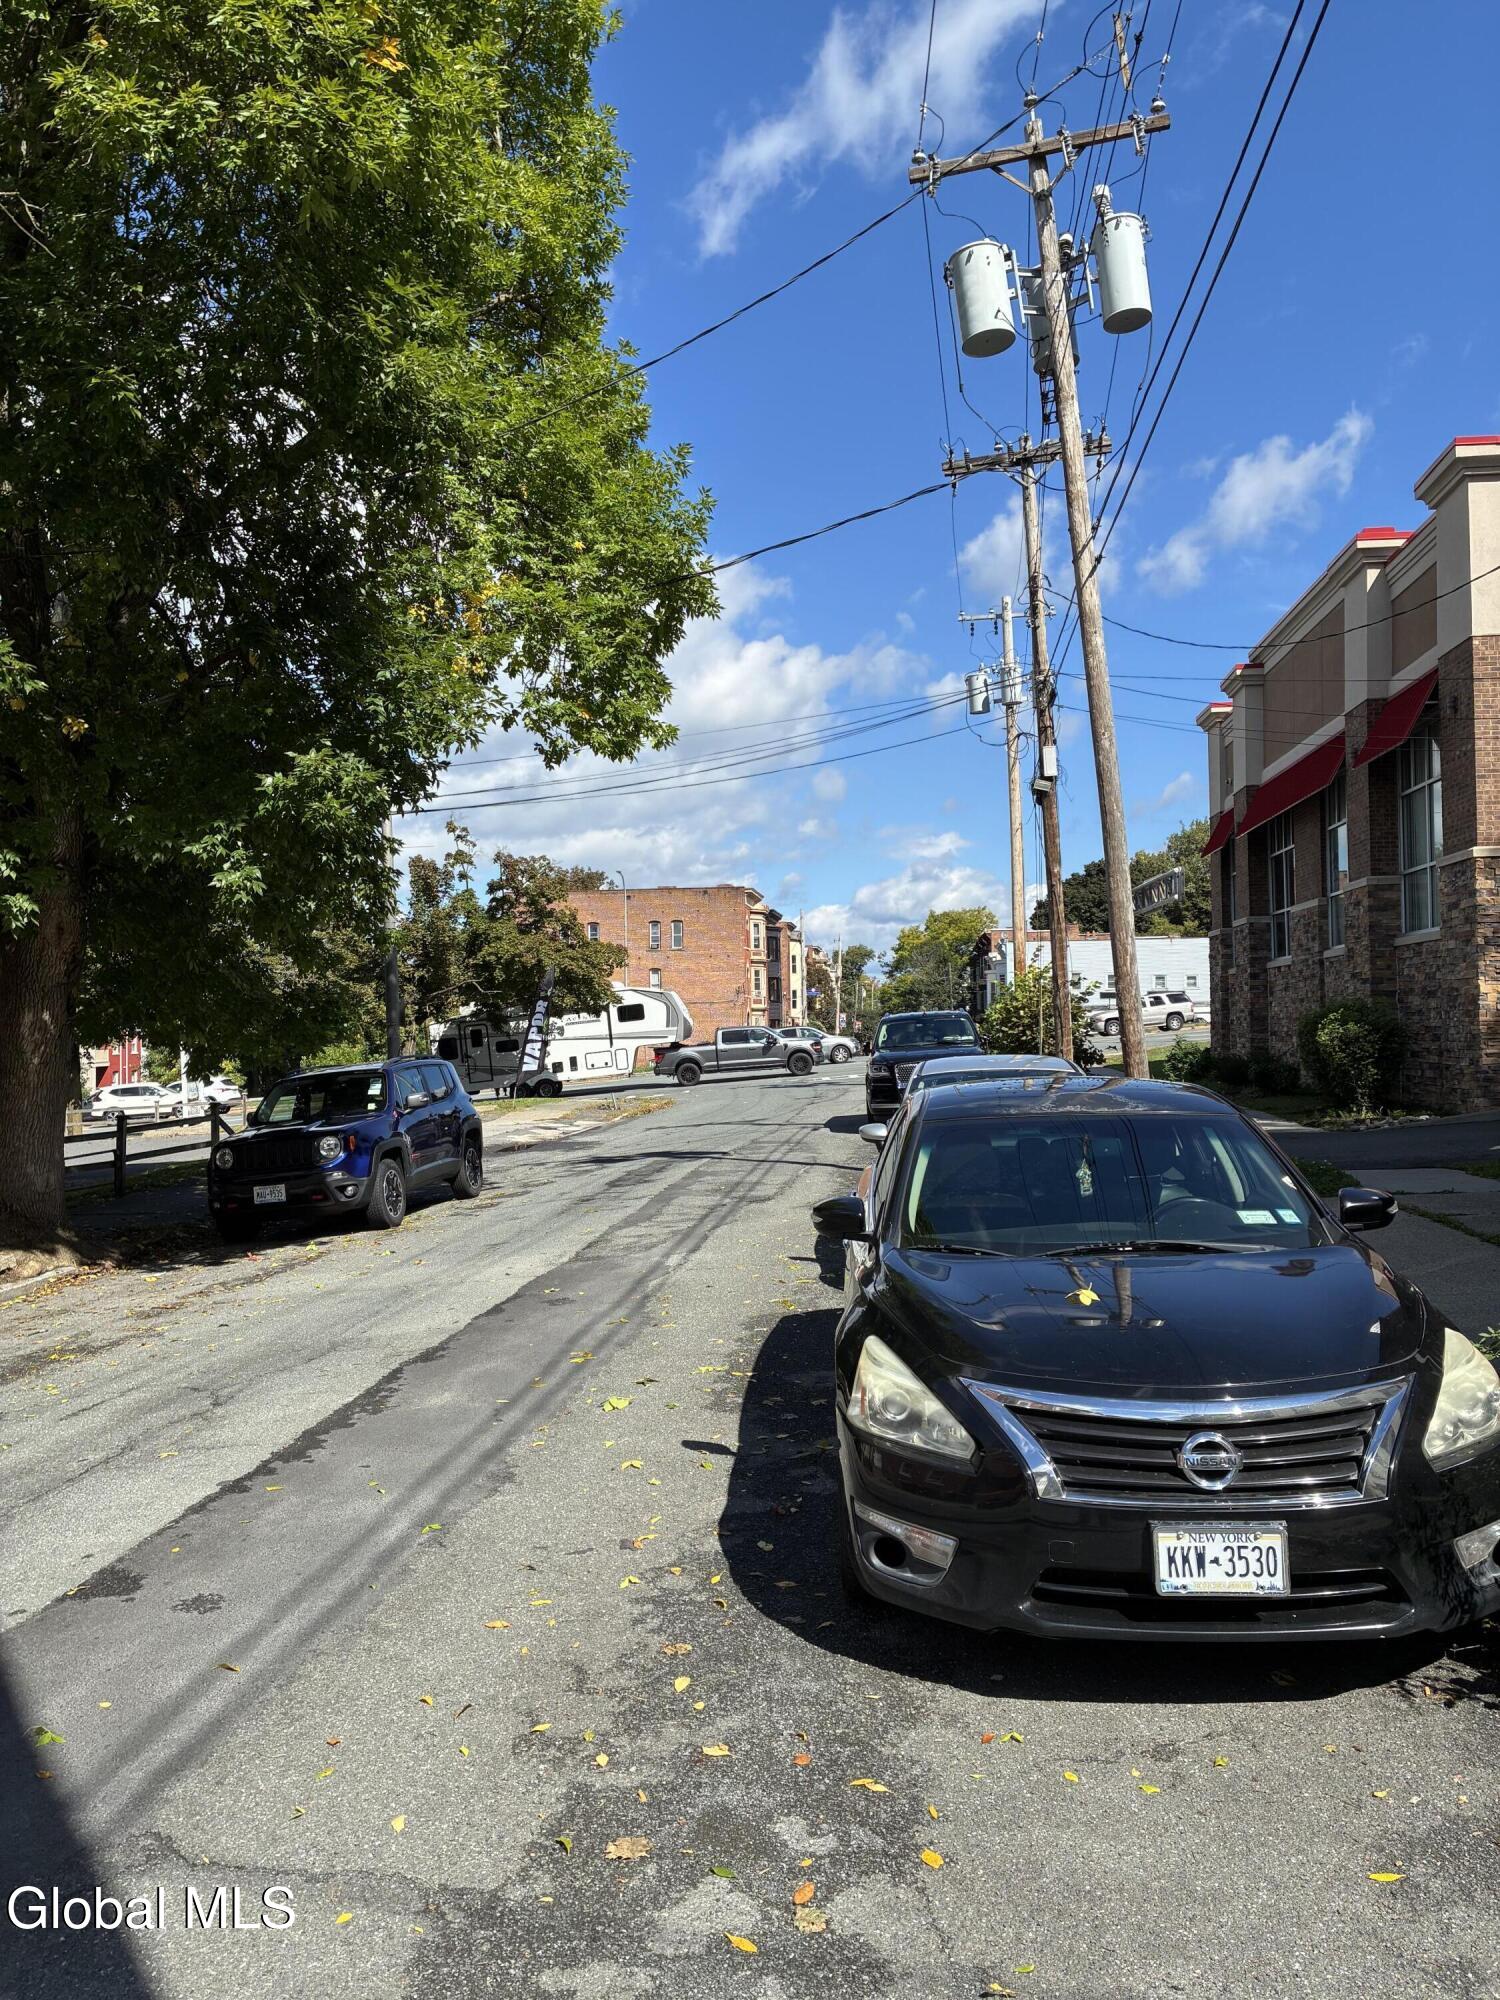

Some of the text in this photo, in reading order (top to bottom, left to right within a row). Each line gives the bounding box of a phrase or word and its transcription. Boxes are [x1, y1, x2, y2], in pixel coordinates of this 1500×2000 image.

[522, 1000, 549, 1072] VAPOR
[1185, 1457, 1237, 1467] NISSAN
[1188, 1533, 1254, 1544] NEW YORK
